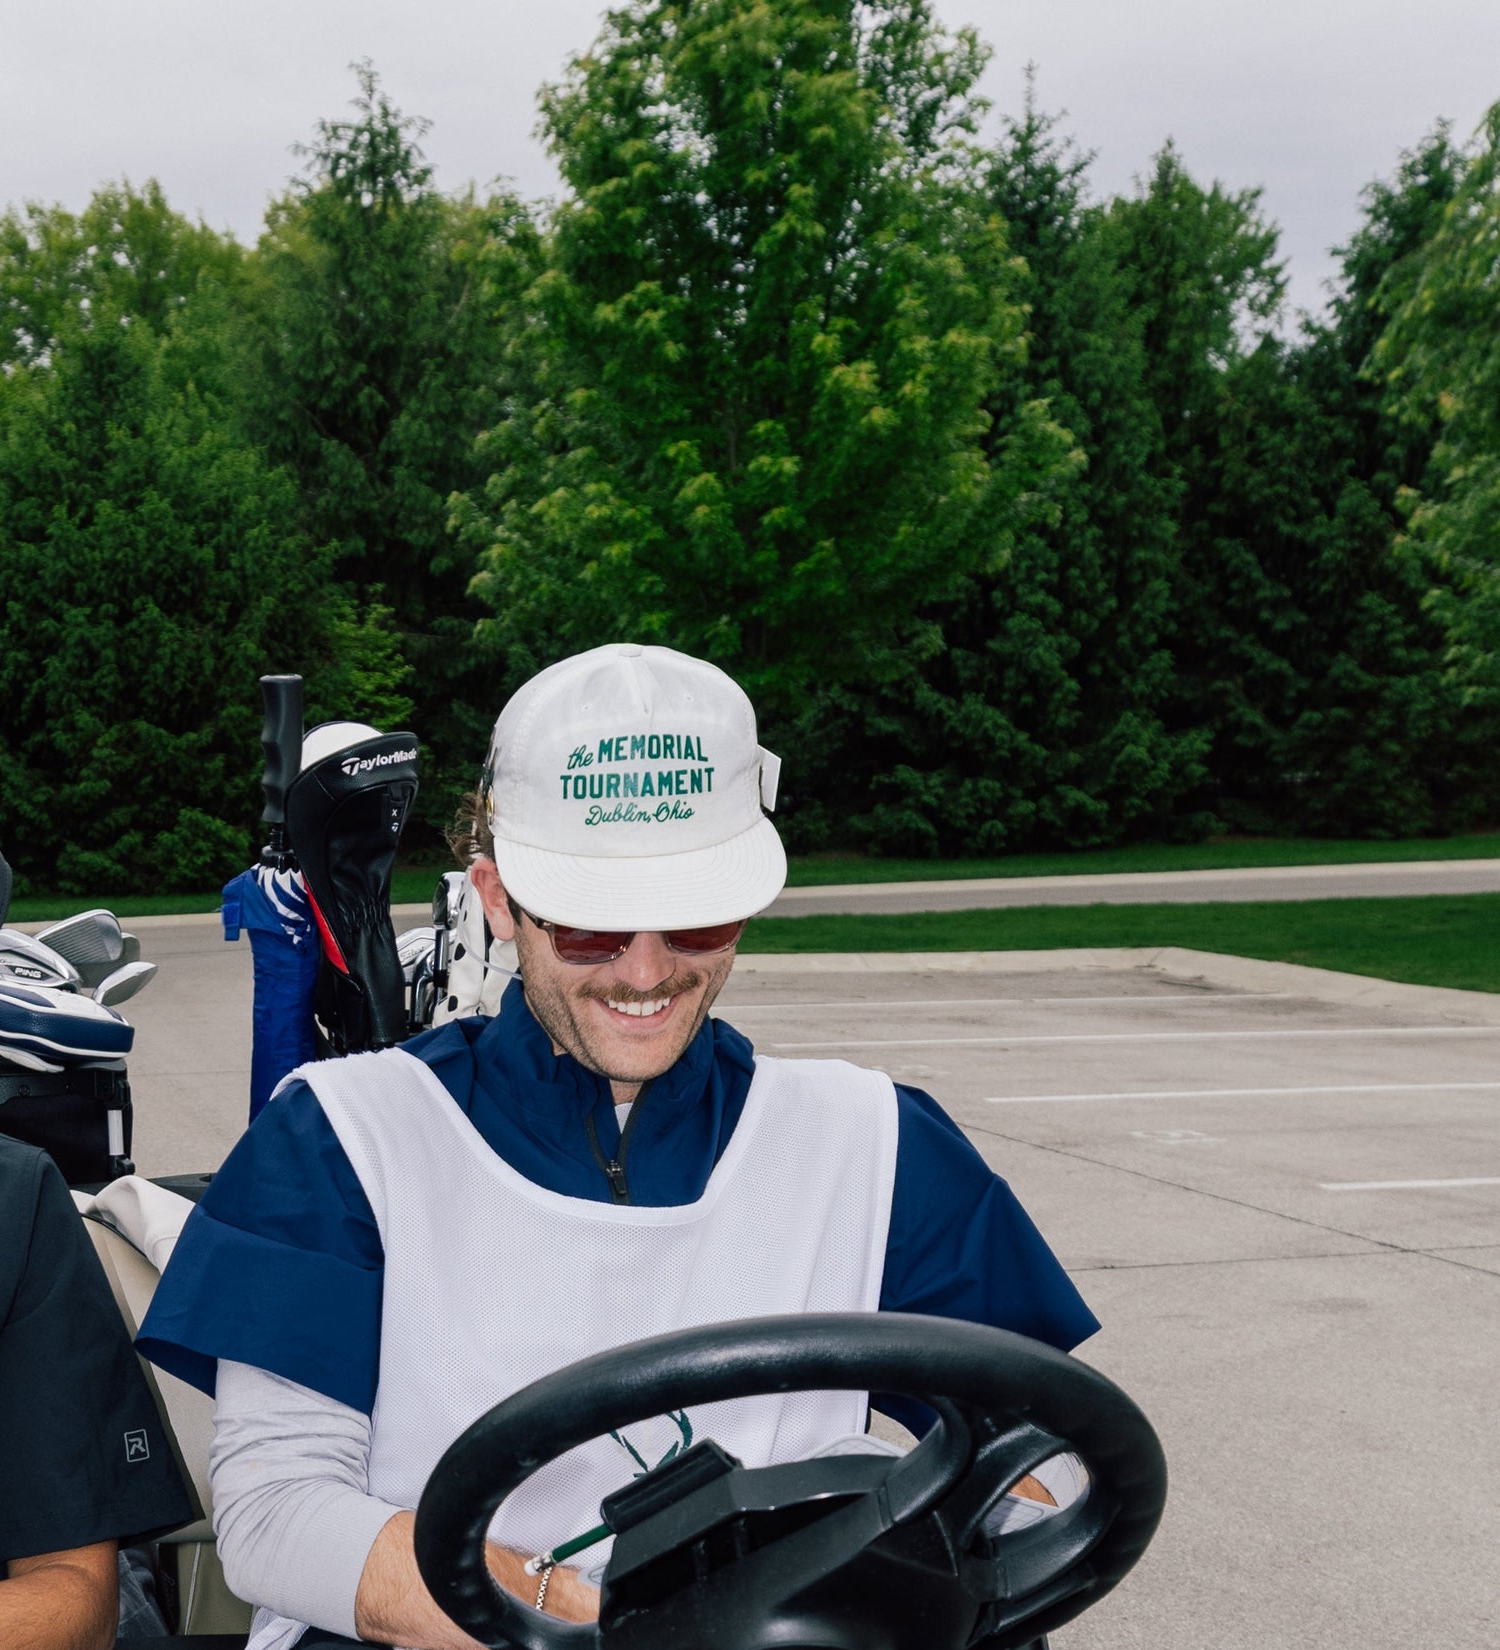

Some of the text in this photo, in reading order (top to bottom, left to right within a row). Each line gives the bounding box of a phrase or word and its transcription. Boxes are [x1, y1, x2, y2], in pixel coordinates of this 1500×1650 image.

[341, 748, 417, 776] TaylorMade
[567, 734, 709, 770] the MEMORIAL
[559, 767, 715, 800] TOURNAMENT
[14, 967, 42, 979] PING
